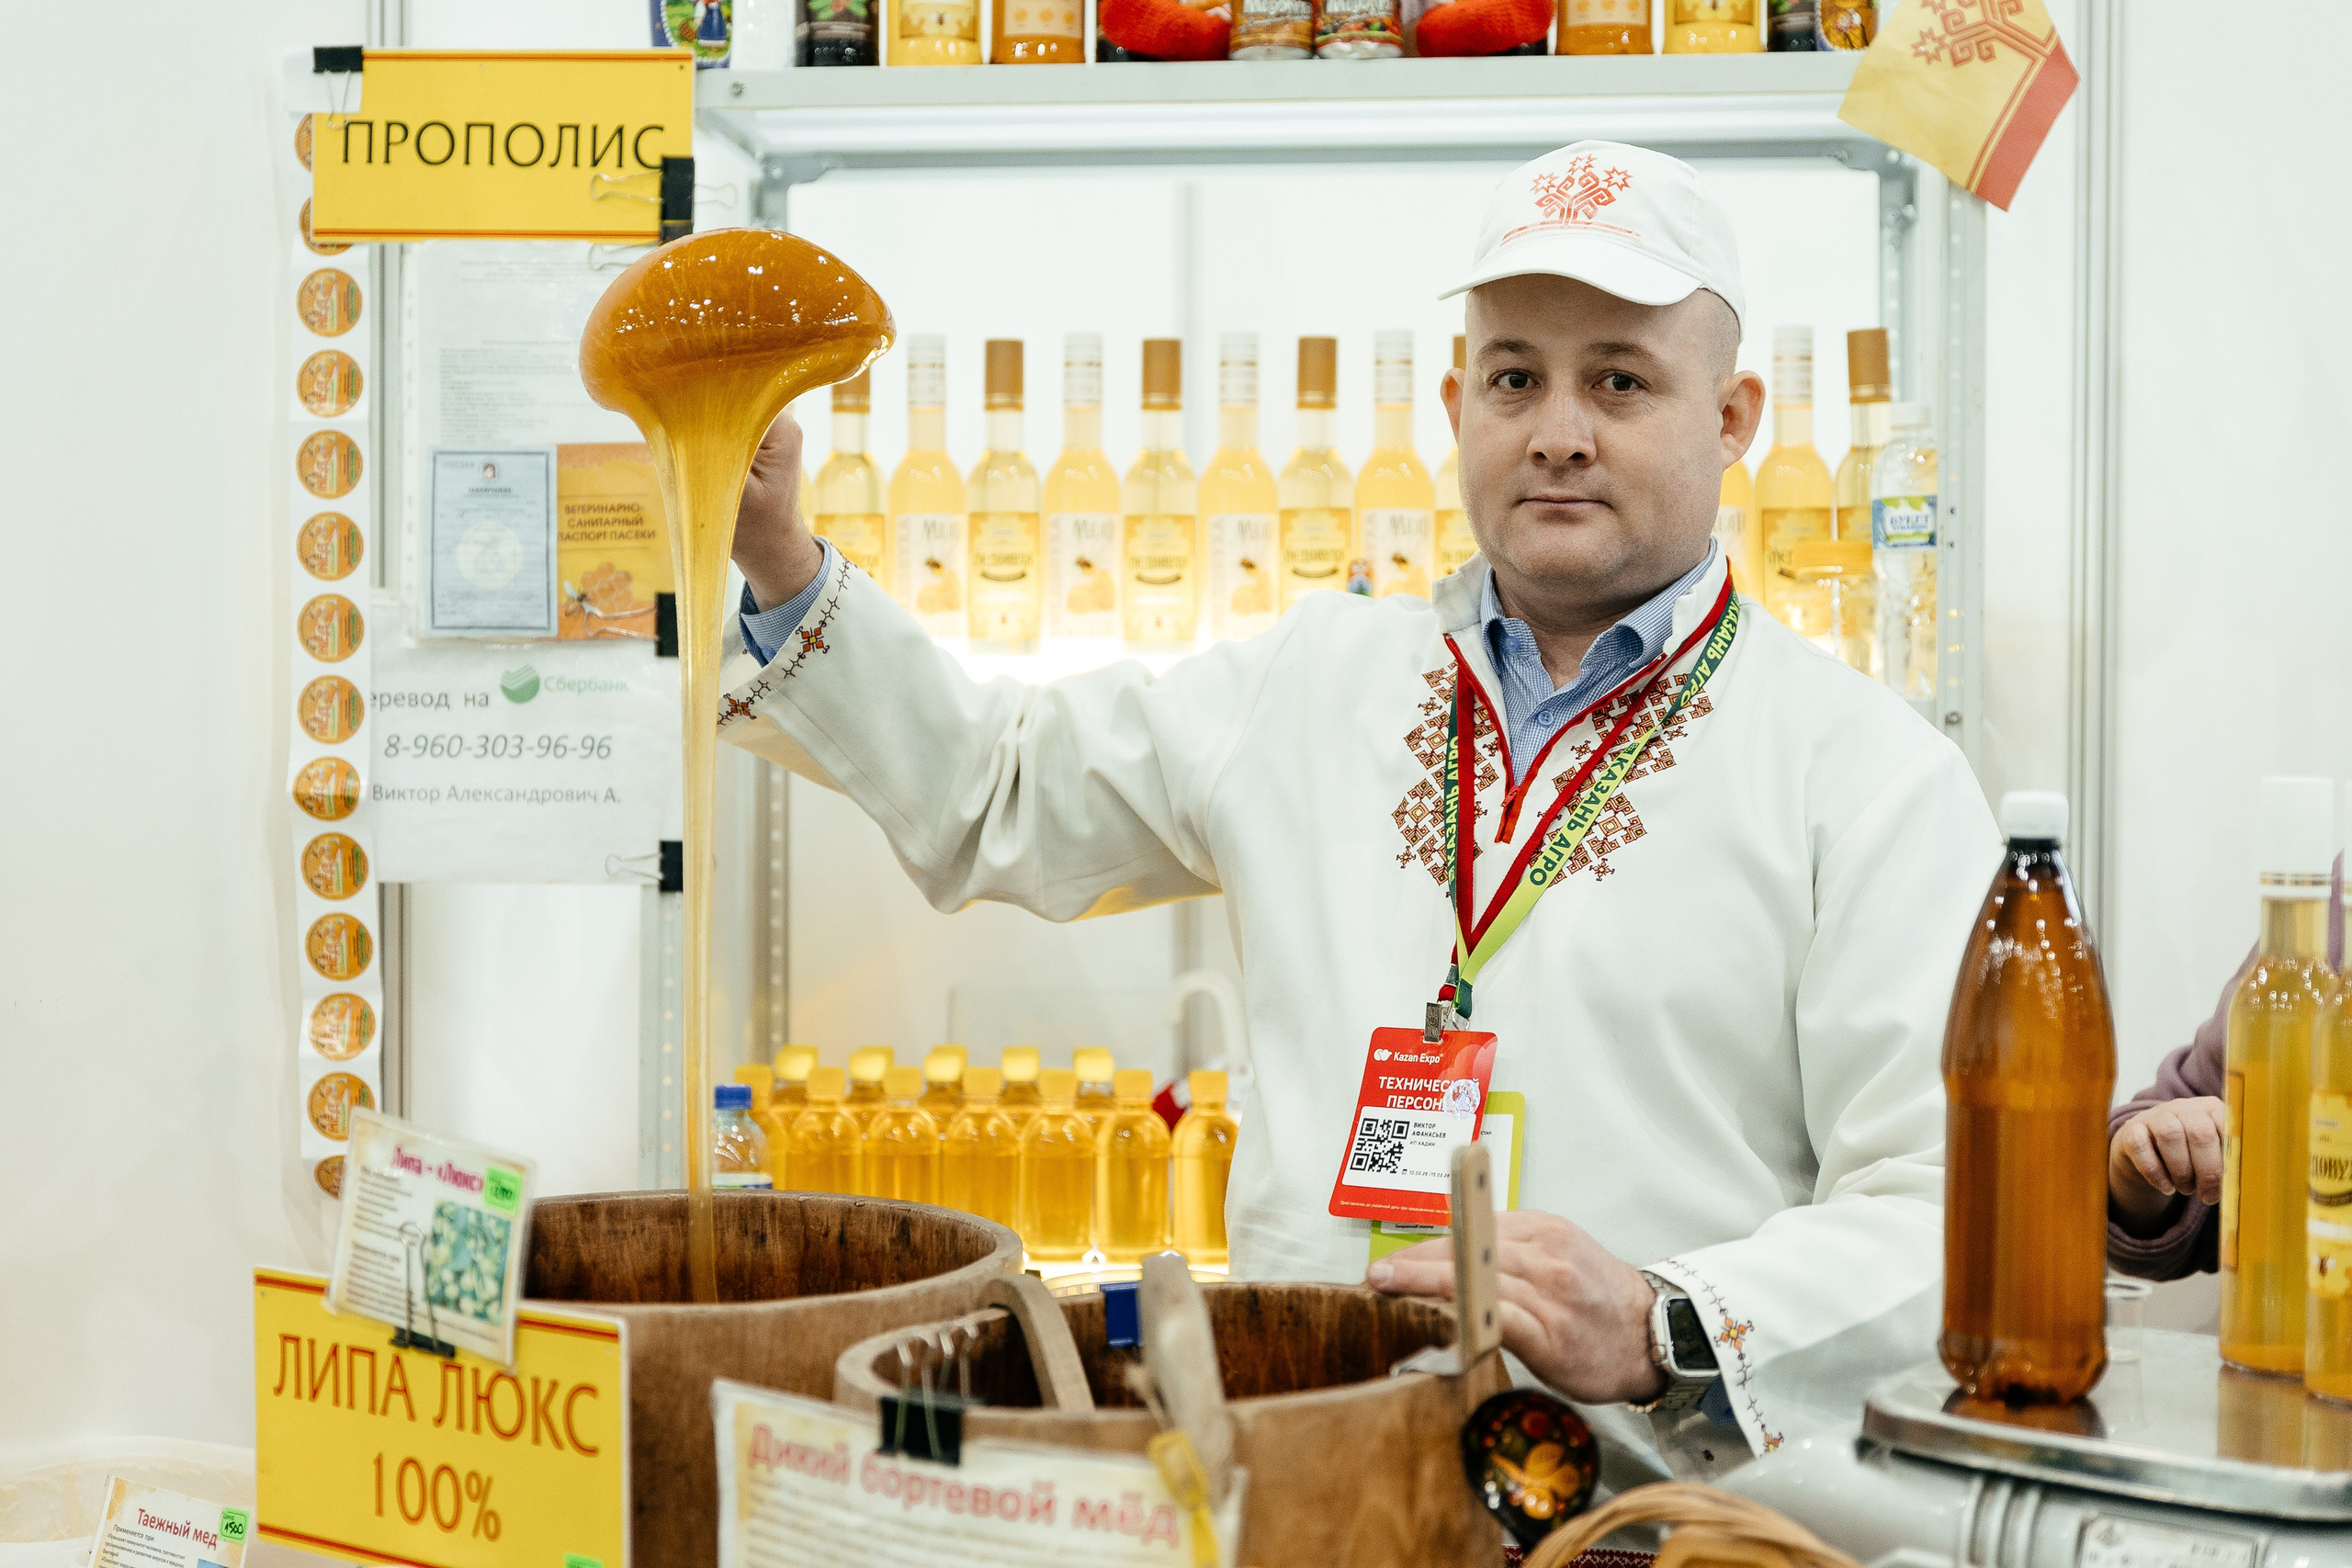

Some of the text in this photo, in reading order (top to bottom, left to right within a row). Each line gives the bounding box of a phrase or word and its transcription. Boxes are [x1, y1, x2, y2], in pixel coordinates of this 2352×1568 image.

[342, 120, 665, 170] ПРОПОЛИС
[567, 513, 643, 528] САНИТАРНЫЙ
[609, 528, 655, 541] ПАСЕКИ
[1680, 600, 1740, 707] КАЗАНЬ АГРО
[370, 675, 629, 712] еревод на Сбербанк
[384, 734, 613, 759] 8-960-303-96-96
[372, 784, 621, 806] Виктор Александрович А.
[1445, 784, 1459, 865] КАЗАНЬ
[1530, 757, 1629, 886] КАЗАНЬ АГРО
[1393, 1052, 1441, 1065] Kazan Expo
[1378, 1076, 1479, 1093] ТЕХНИЧЕС
[1386, 1094, 1444, 1111] ПЕРСОН
[274, 1334, 600, 1458] ЛИПА ЛЮКС
[374, 1452, 503, 1543] 100%
[748, 1423, 851, 1484] Дикий
[859, 1450, 1056, 1526] бортевой
[1071, 1491, 1181, 1548] мёд
[113, 1524, 143, 1539] Применяется
[138, 1507, 218, 1551] Таежный мед
